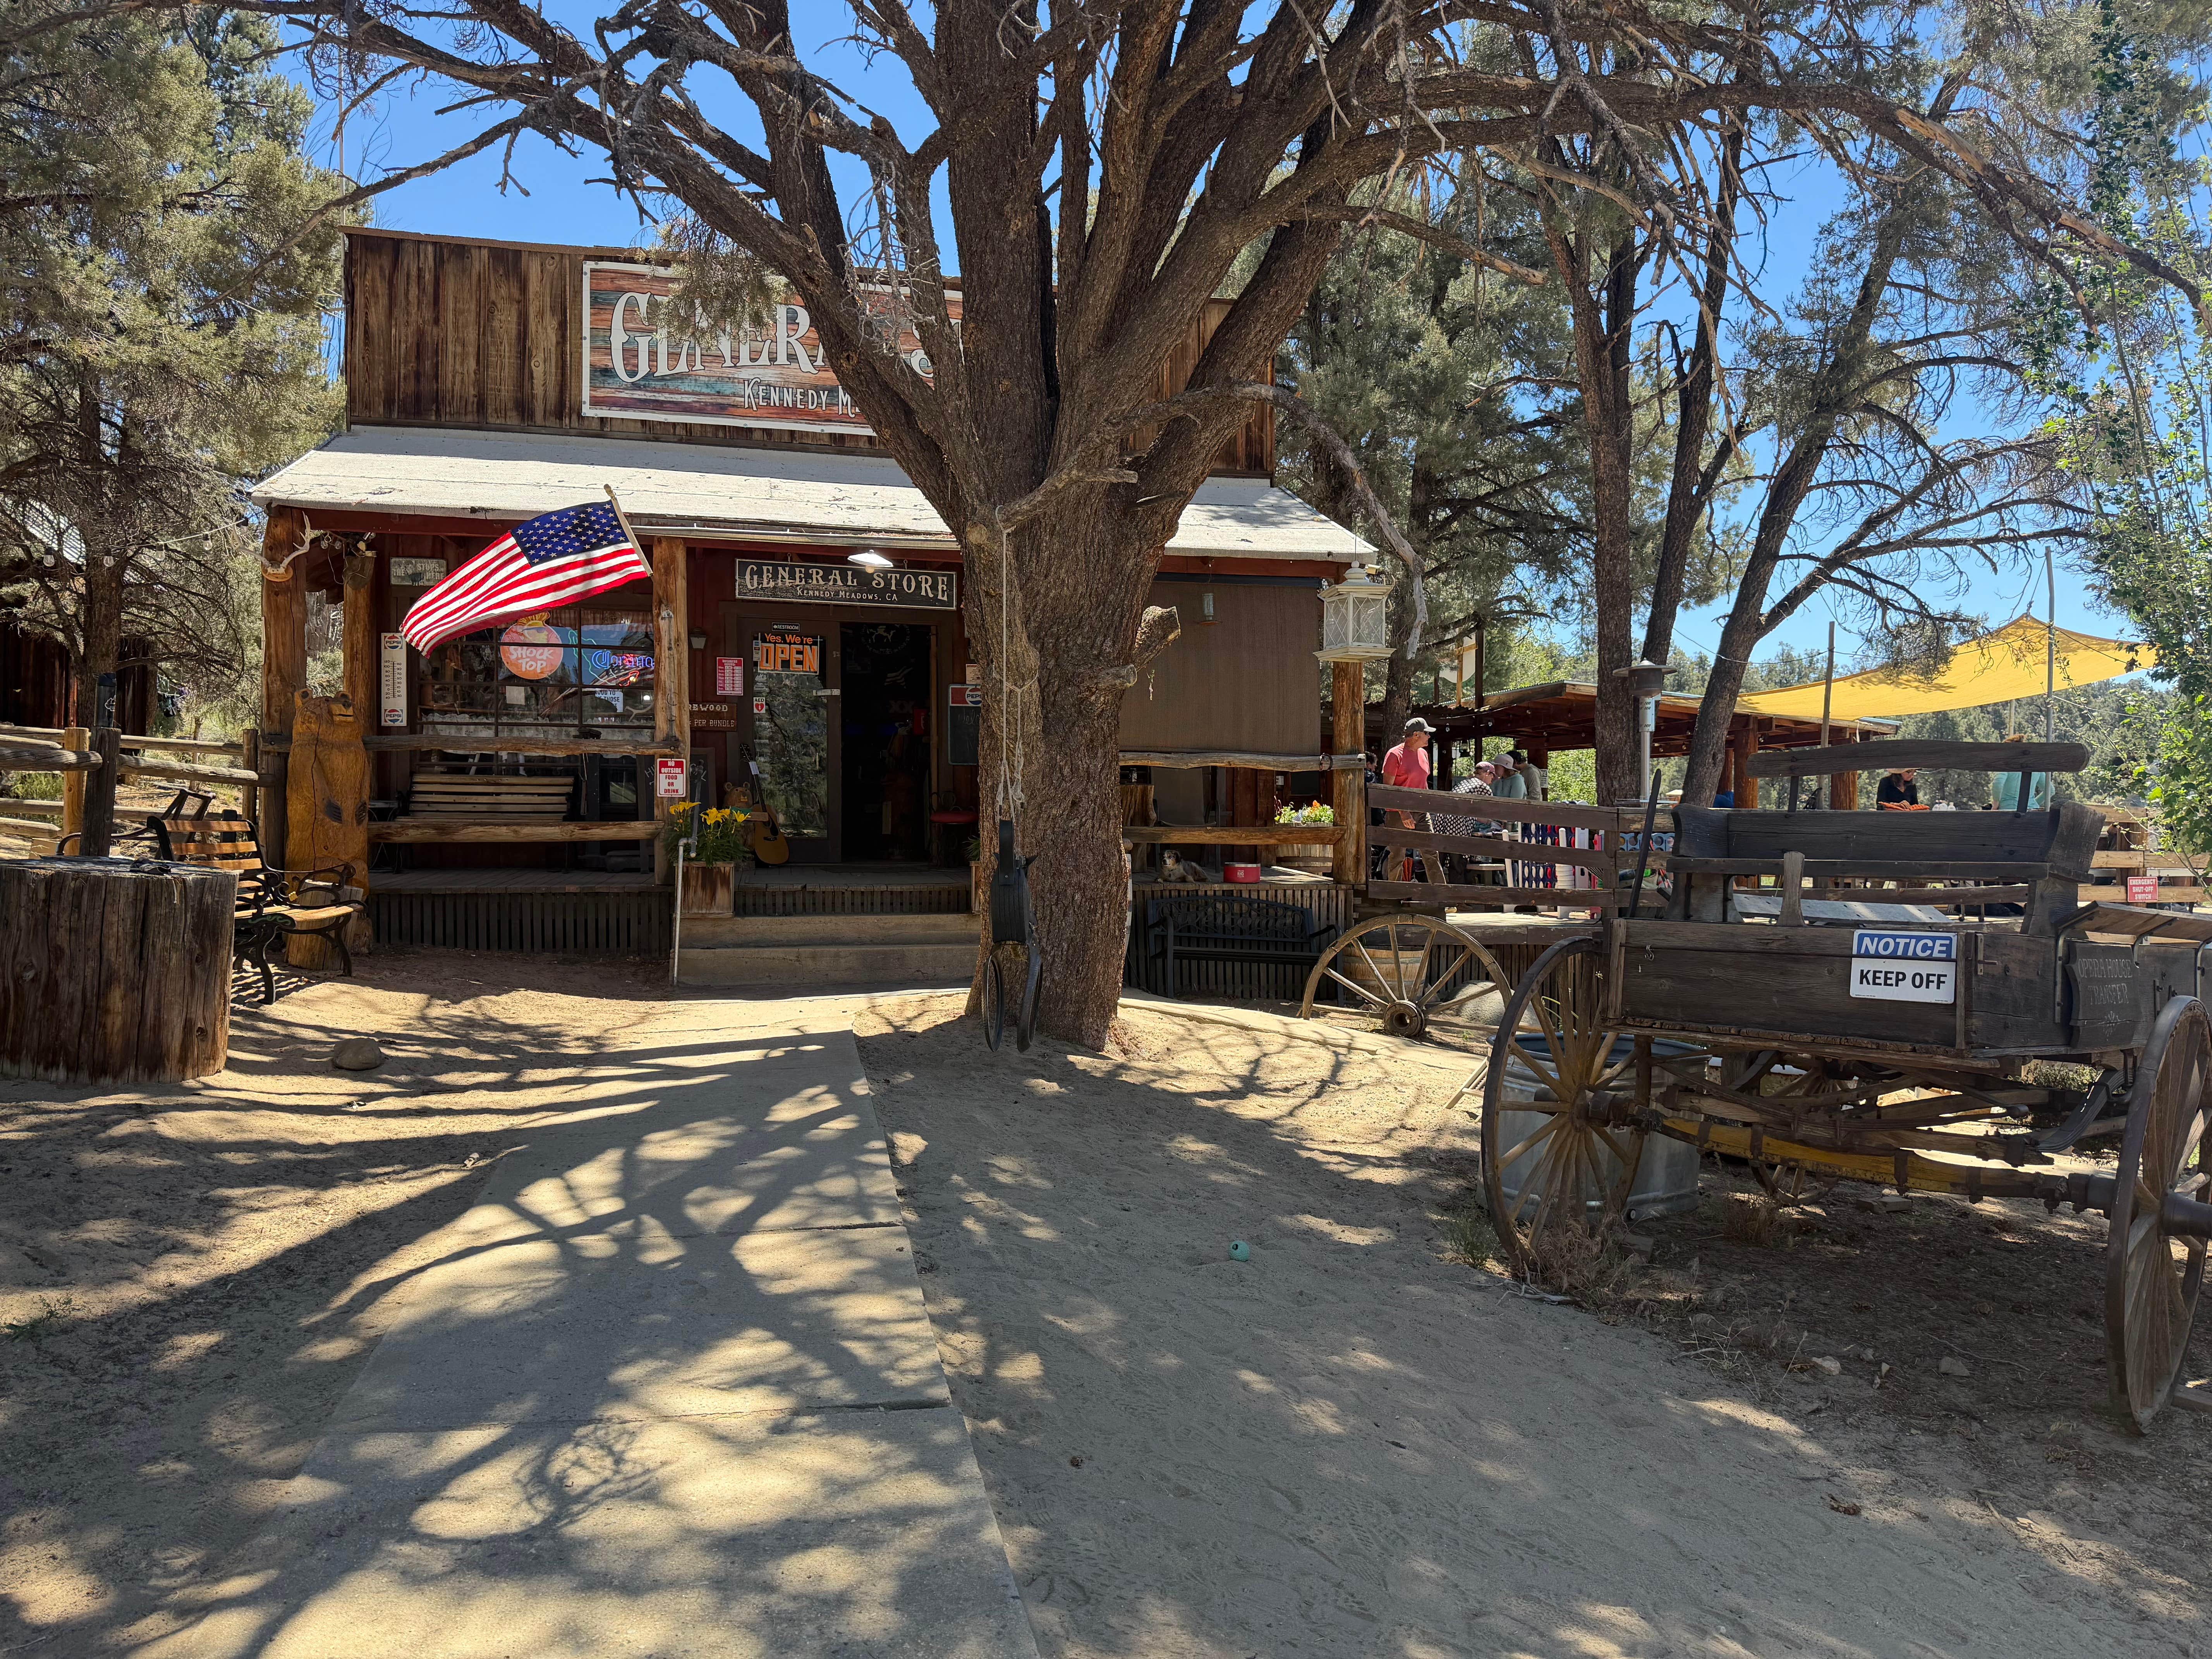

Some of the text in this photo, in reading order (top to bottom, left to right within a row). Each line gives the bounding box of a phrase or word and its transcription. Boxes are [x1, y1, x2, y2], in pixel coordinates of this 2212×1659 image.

[743, 378, 829, 411] KENNEDY
[426, 571, 444, 580] HERE
[745, 564, 950, 601] GENERAL STORE
[797, 586, 834, 598] KENNEDY
[886, 593, 898, 601] CA
[785, 634, 813, 644] We're
[508, 646, 554, 660] SHOCK
[760, 642, 818, 672] OPEN
[518, 658, 546, 673] TOP
[1860, 936, 1950, 957] NOTICE
[2078, 958, 2133, 978] OPERA HOUSE
[1859, 969, 1948, 990] KEEP OFF
[2088, 983, 2129, 1005] TRANSFER
